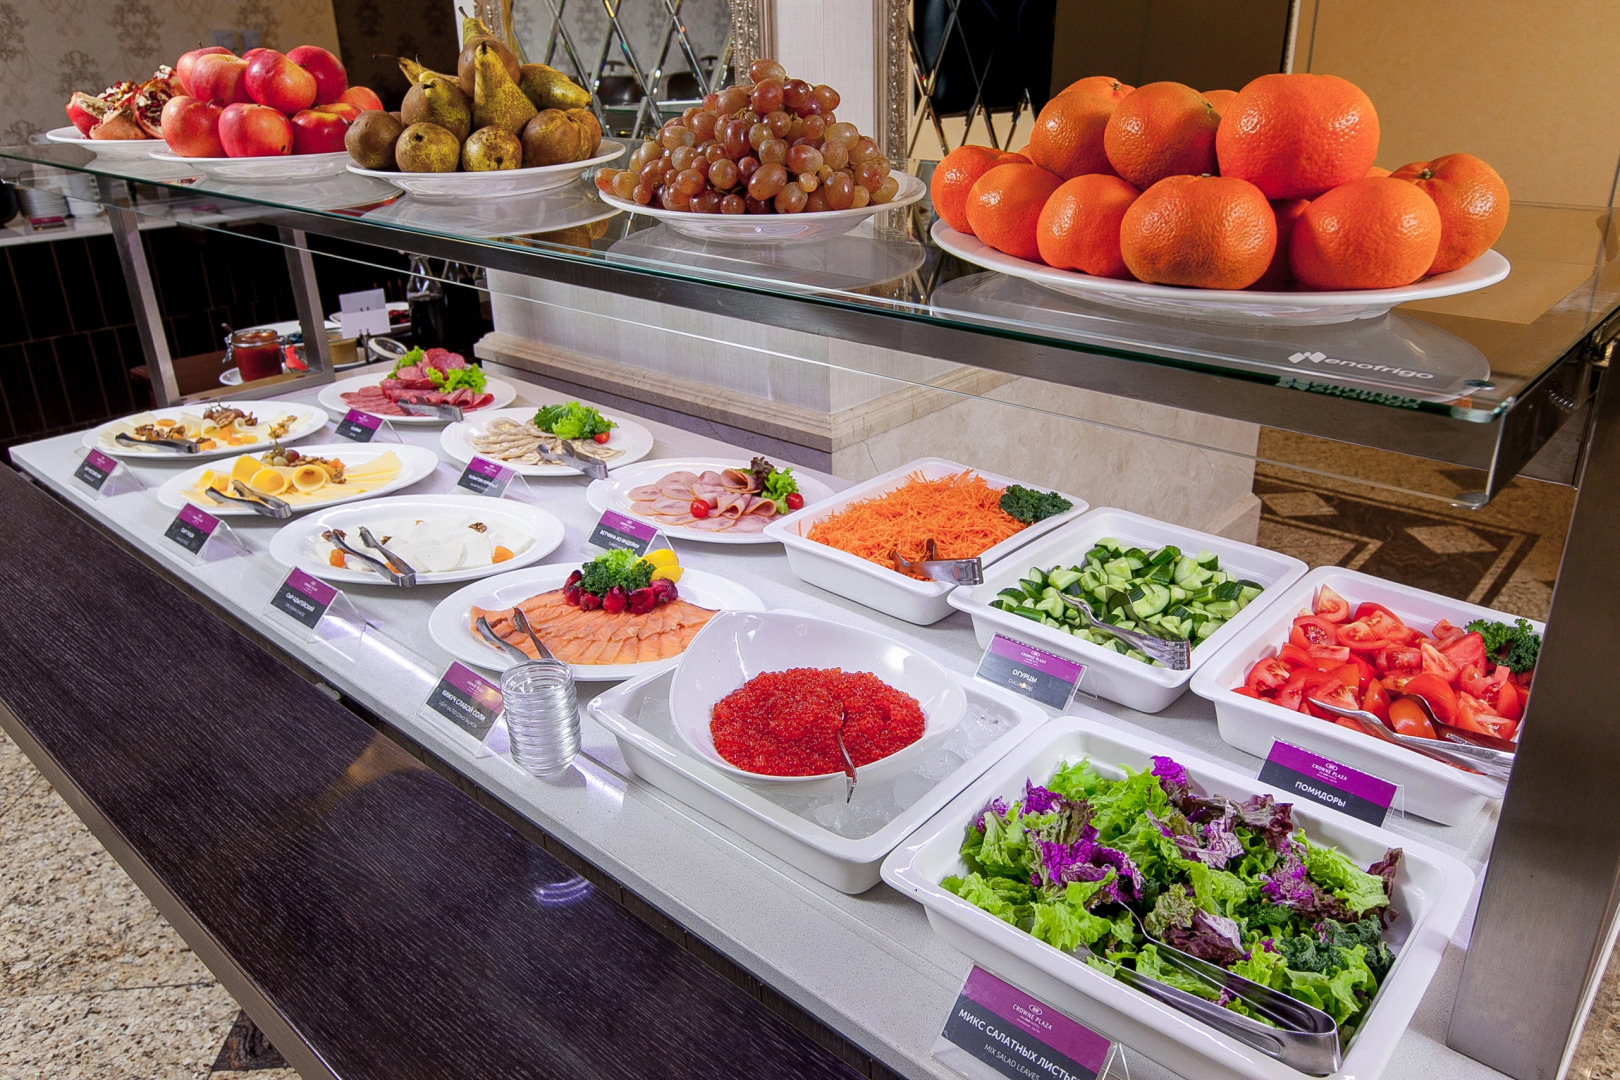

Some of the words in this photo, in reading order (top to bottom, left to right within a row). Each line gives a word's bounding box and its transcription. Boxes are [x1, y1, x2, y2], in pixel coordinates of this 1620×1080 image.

[1012, 669, 1038, 683] ОГУРЦЫ
[454, 697, 474, 713] СЛАБОЙ
[471, 708, 486, 722] СОЛИ
[1312, 763, 1331, 775] CROWNE
[1331, 771, 1347, 781] PLAZA
[1294, 781, 1347, 808] ПОМИДОРЫ
[1012, 1003, 1035, 1021] CROWNE
[1034, 1016, 1053, 1031] PLAZA
[958, 1008, 986, 1031] МИКС
[985, 1025, 1038, 1063] САЛАТНЫХ
[983, 1044, 997, 1056] MIX
[995, 1051, 1017, 1068] SALAD
[1016, 1063, 1041, 1080] LEAVES
